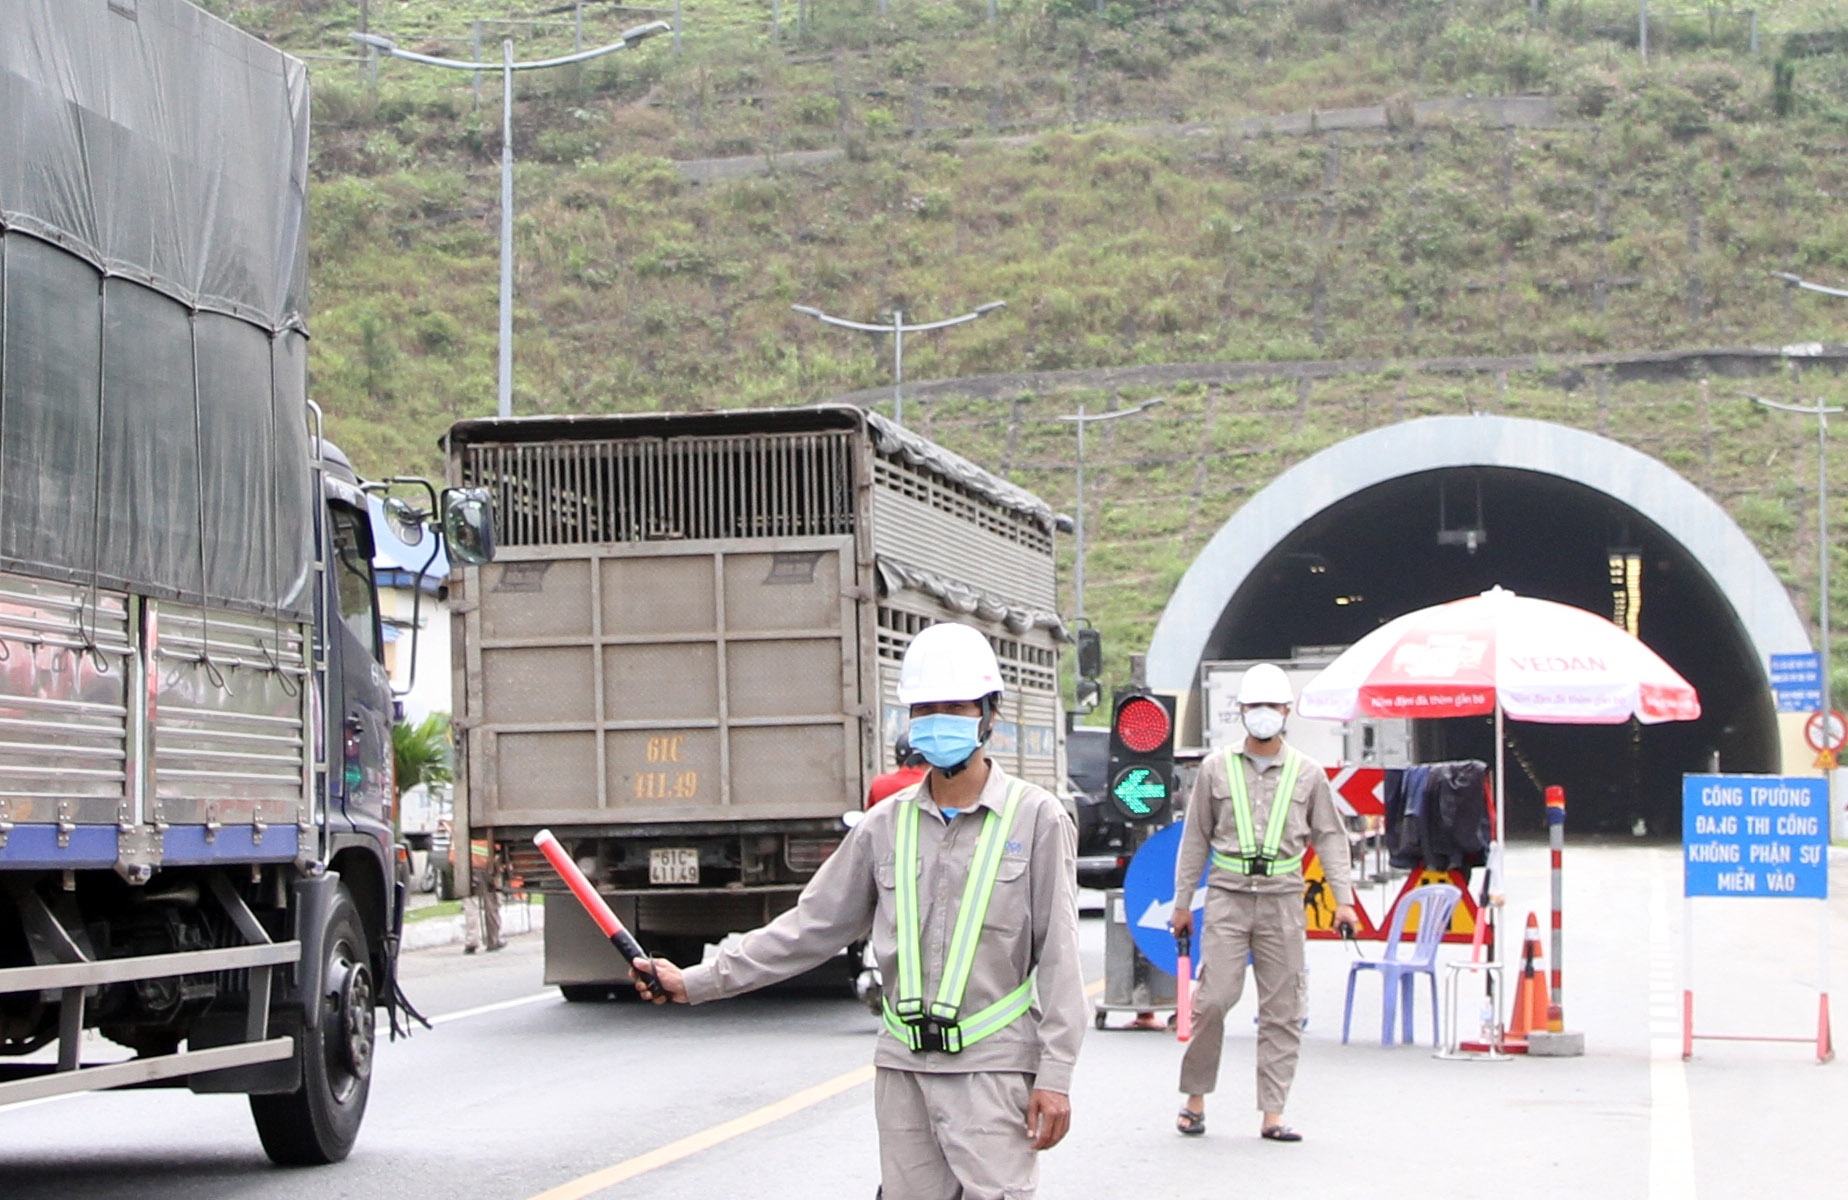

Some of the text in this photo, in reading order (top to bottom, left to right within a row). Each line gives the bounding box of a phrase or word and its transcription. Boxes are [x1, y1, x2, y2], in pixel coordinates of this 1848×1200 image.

[1510, 657, 1608, 672] VEDAN
[646, 735, 685, 762] 61C
[1702, 784, 1743, 806] CÔNG
[1745, 816, 1770, 835] THI
[1777, 813, 1818, 835] CÔNG
[660, 851, 687, 865] 61C
[1689, 840, 1821, 867] KHÔNG PHẬN SỰ
[1767, 868, 1796, 891] VÀO
